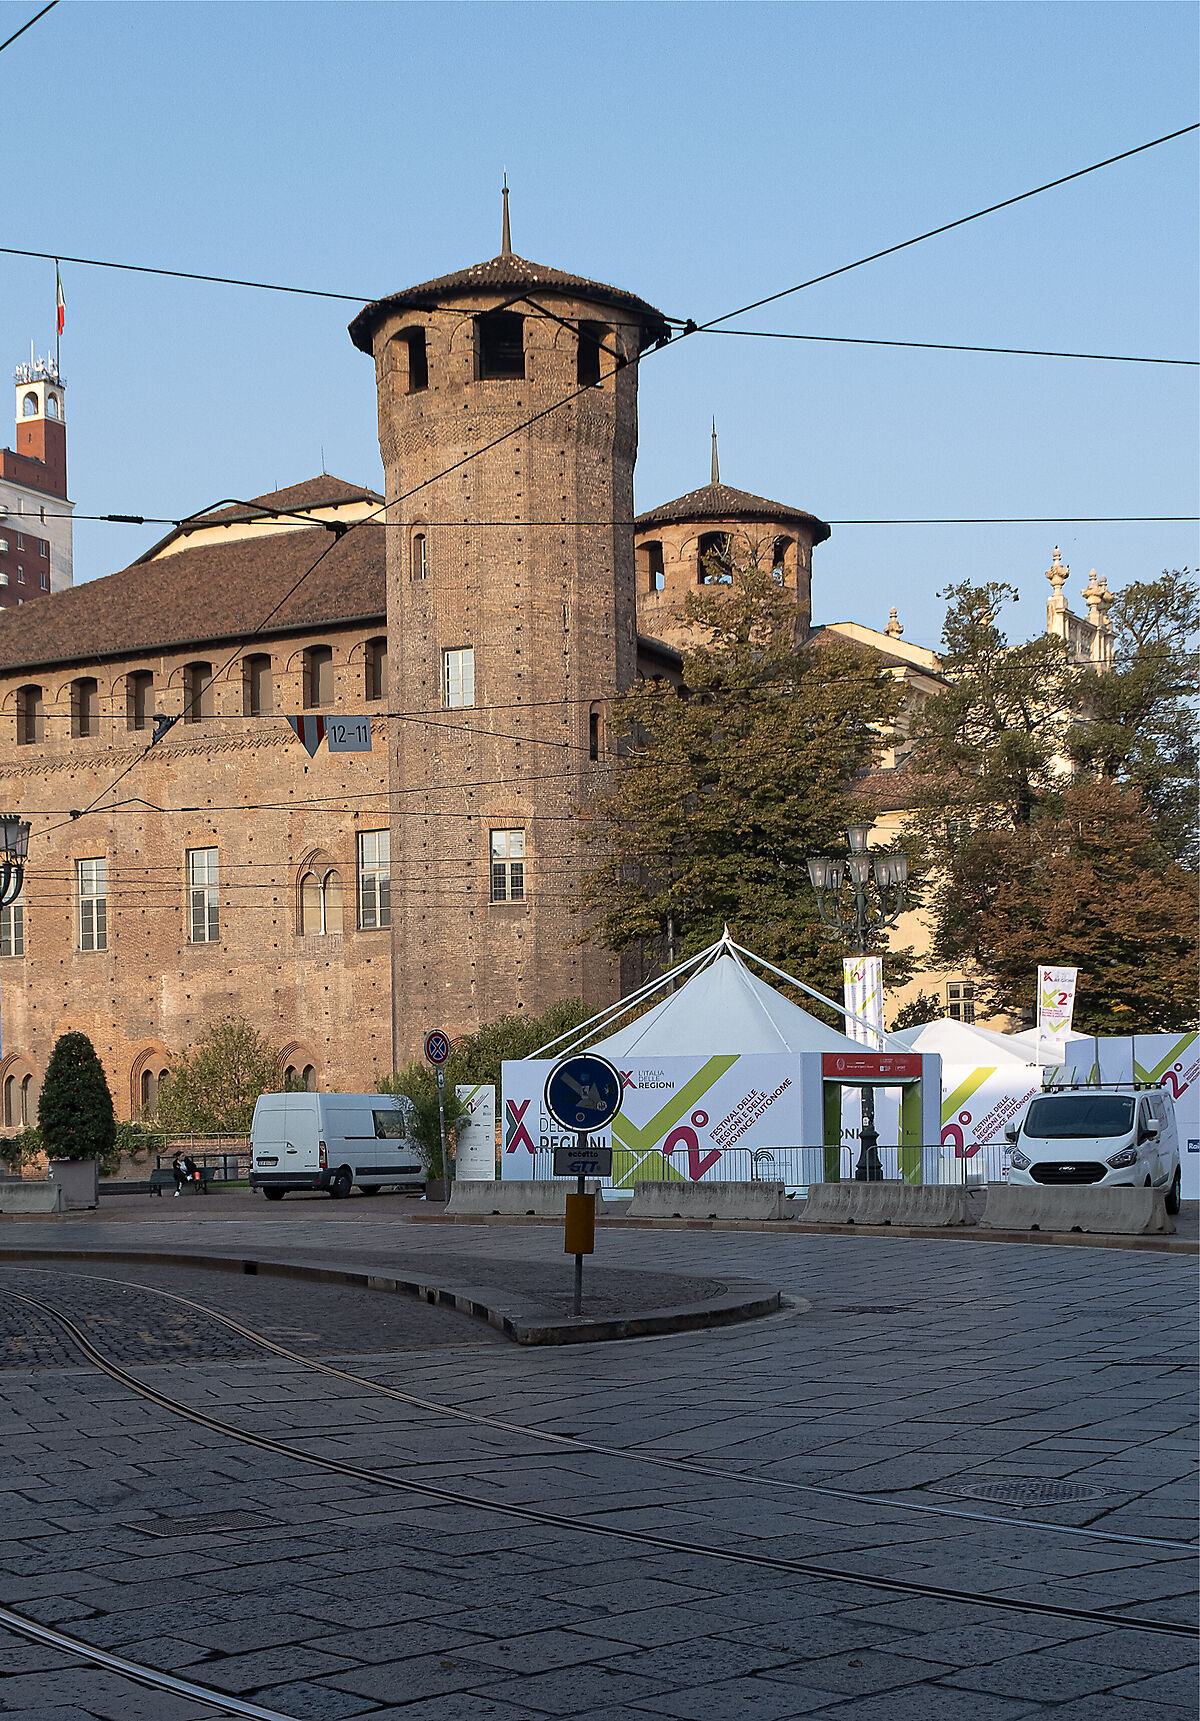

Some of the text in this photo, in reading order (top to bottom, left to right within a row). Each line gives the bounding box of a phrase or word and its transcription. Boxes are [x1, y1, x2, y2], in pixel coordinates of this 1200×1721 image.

[331, 725, 368, 743] 12-11
[638, 1081, 675, 1089] REGIONI
[709, 1089, 758, 1139] FESTIVAL DELLE
[715, 1117, 744, 1145] REGIONI
[746, 1091, 768, 1113] DELLE
[722, 1117, 756, 1150] PROVINCE
[754, 1078, 793, 1119] AUTONOME
[971, 1095, 1010, 1135] FESTIVAL DELLE
[976, 1117, 999, 1140] REGIONI
[1000, 1097, 1017, 1115] DELLE
[981, 1087, 1037, 1144] PROVINCE AUTONOME
[539, 1135, 606, 1151] REGINI
